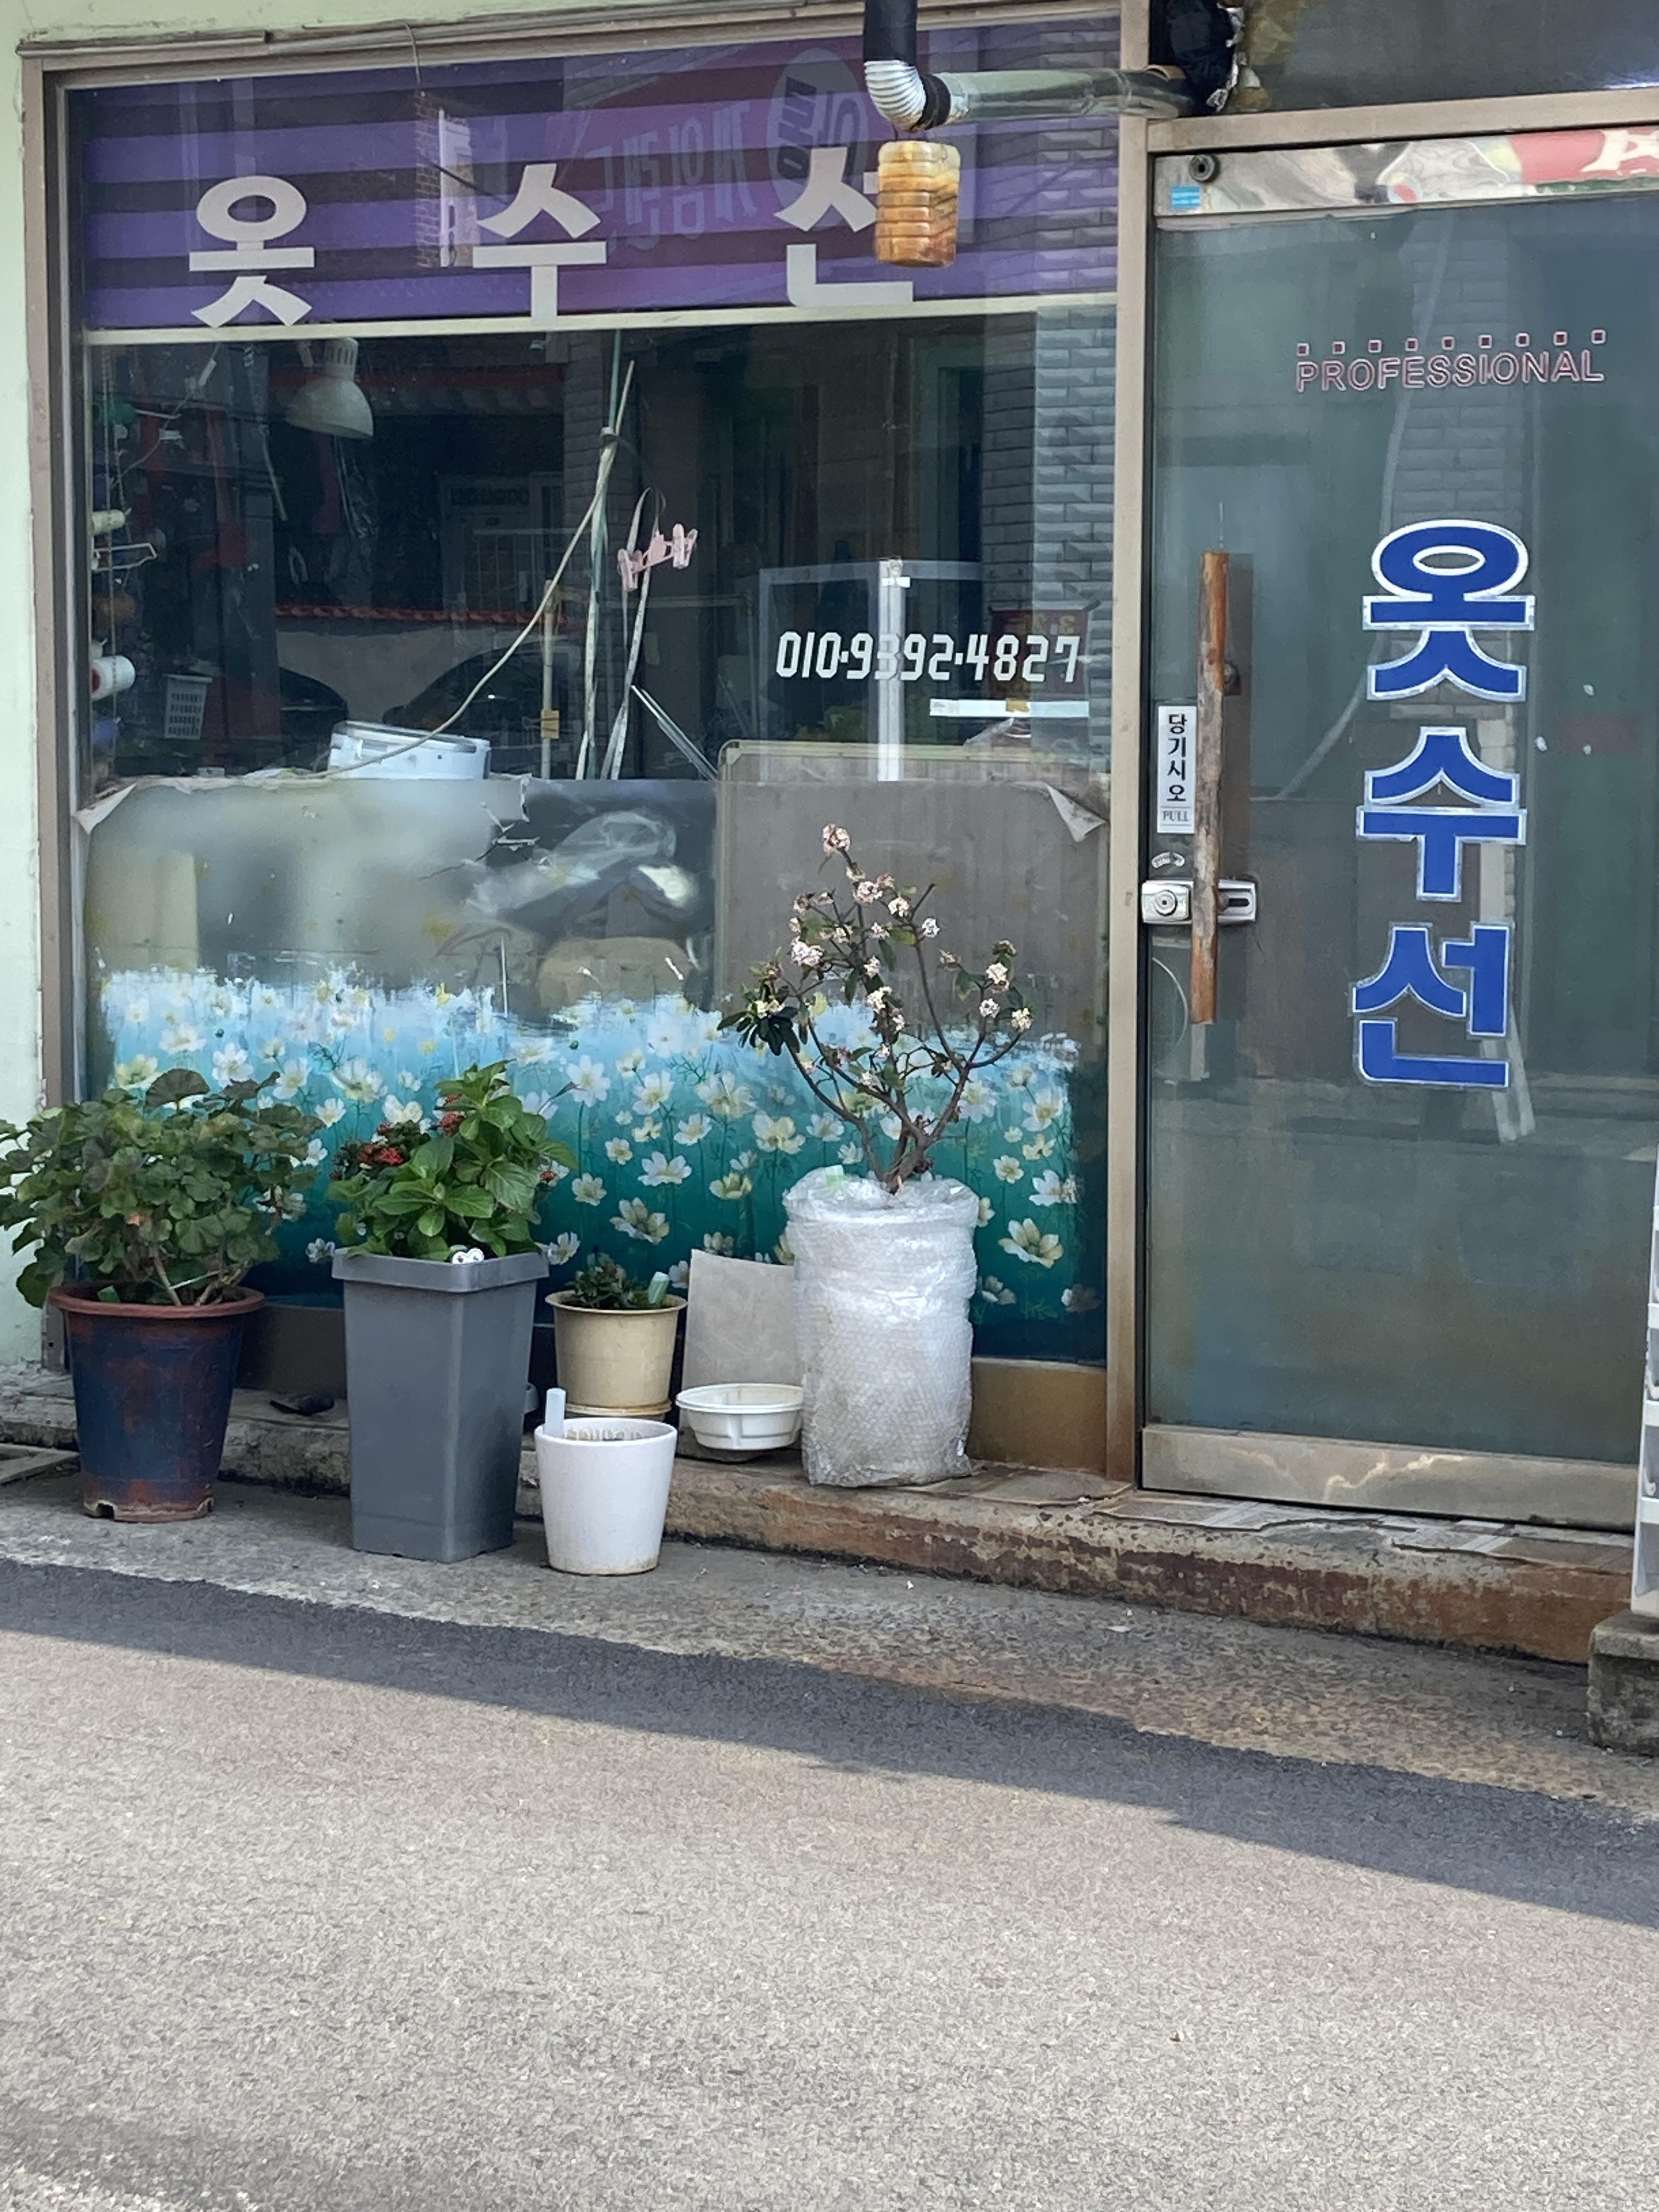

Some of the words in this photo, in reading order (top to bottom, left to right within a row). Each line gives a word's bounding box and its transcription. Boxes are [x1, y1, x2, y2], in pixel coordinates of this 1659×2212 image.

[1297, 351, 1604, 391] PROFESSIONAL
[1167, 714, 1187, 802] 당기시오
[1163, 811, 1189, 822] PULL
[1351, 519, 1535, 1088] 옷수선
